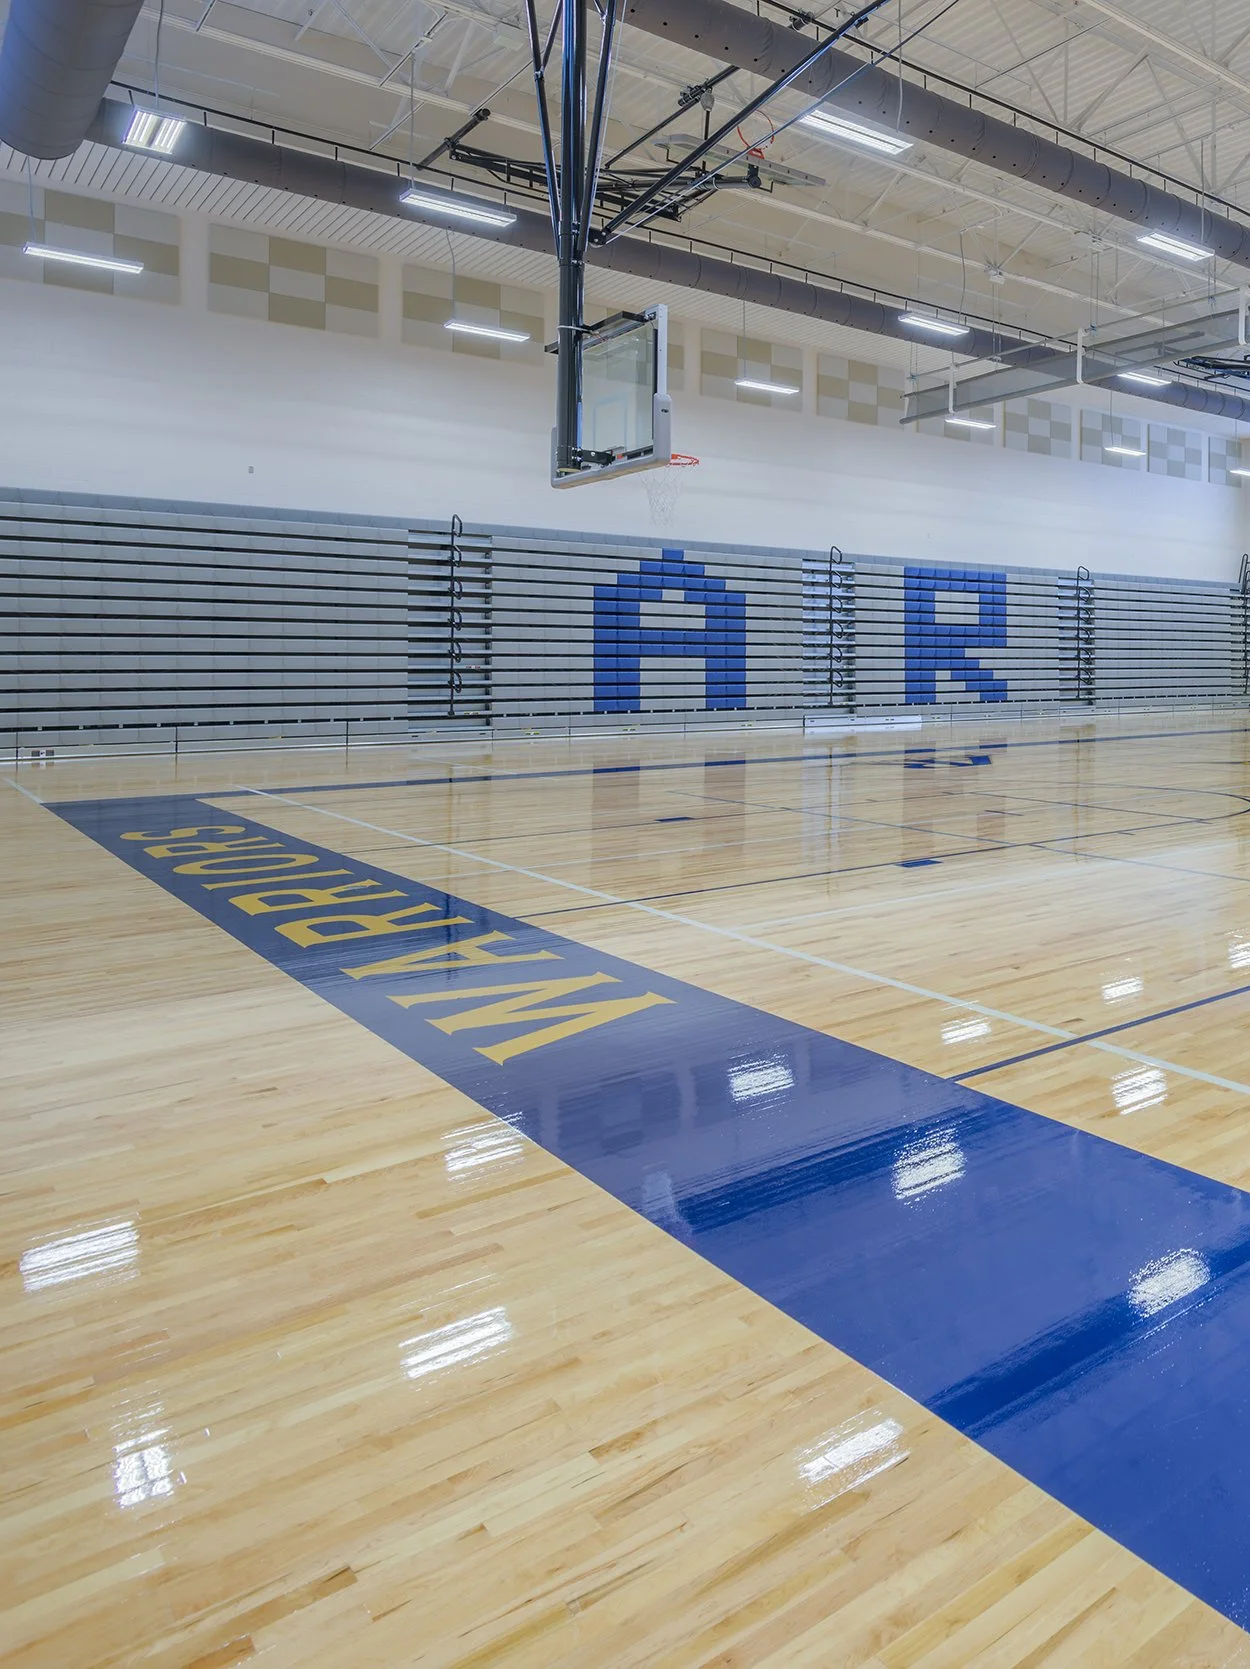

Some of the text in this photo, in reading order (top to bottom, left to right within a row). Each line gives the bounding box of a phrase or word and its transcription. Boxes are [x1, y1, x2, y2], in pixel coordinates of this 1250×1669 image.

[593, 548, 1007, 711] A R
[120, 824, 678, 1066] WARRIORS
